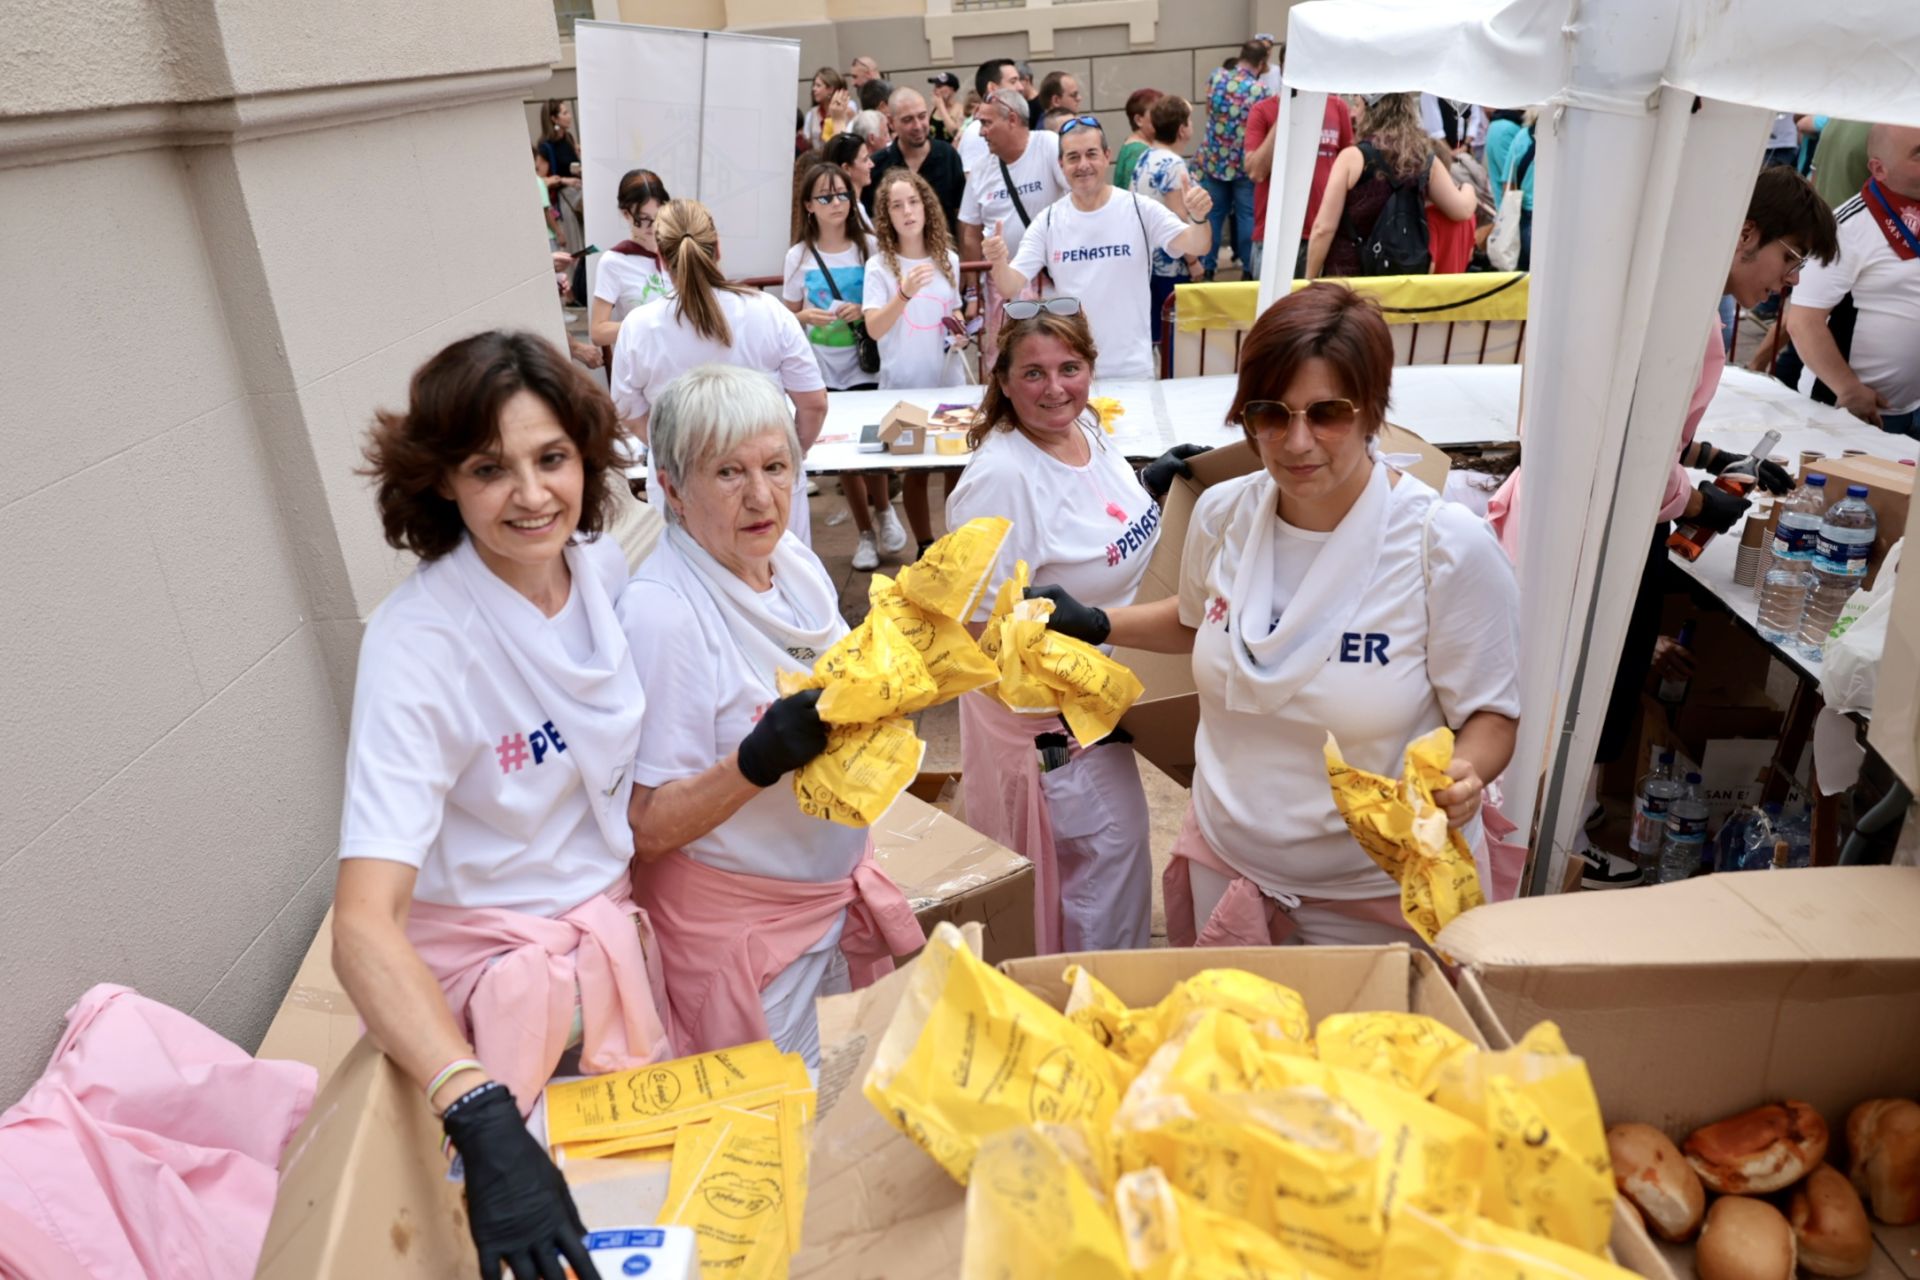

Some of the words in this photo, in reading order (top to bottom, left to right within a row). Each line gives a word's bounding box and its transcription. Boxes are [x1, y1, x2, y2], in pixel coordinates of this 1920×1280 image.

[986, 180, 1043, 201] #PESTER
[1053, 243, 1131, 263] #PEÑASTER
[495, 719, 568, 775] #PE
